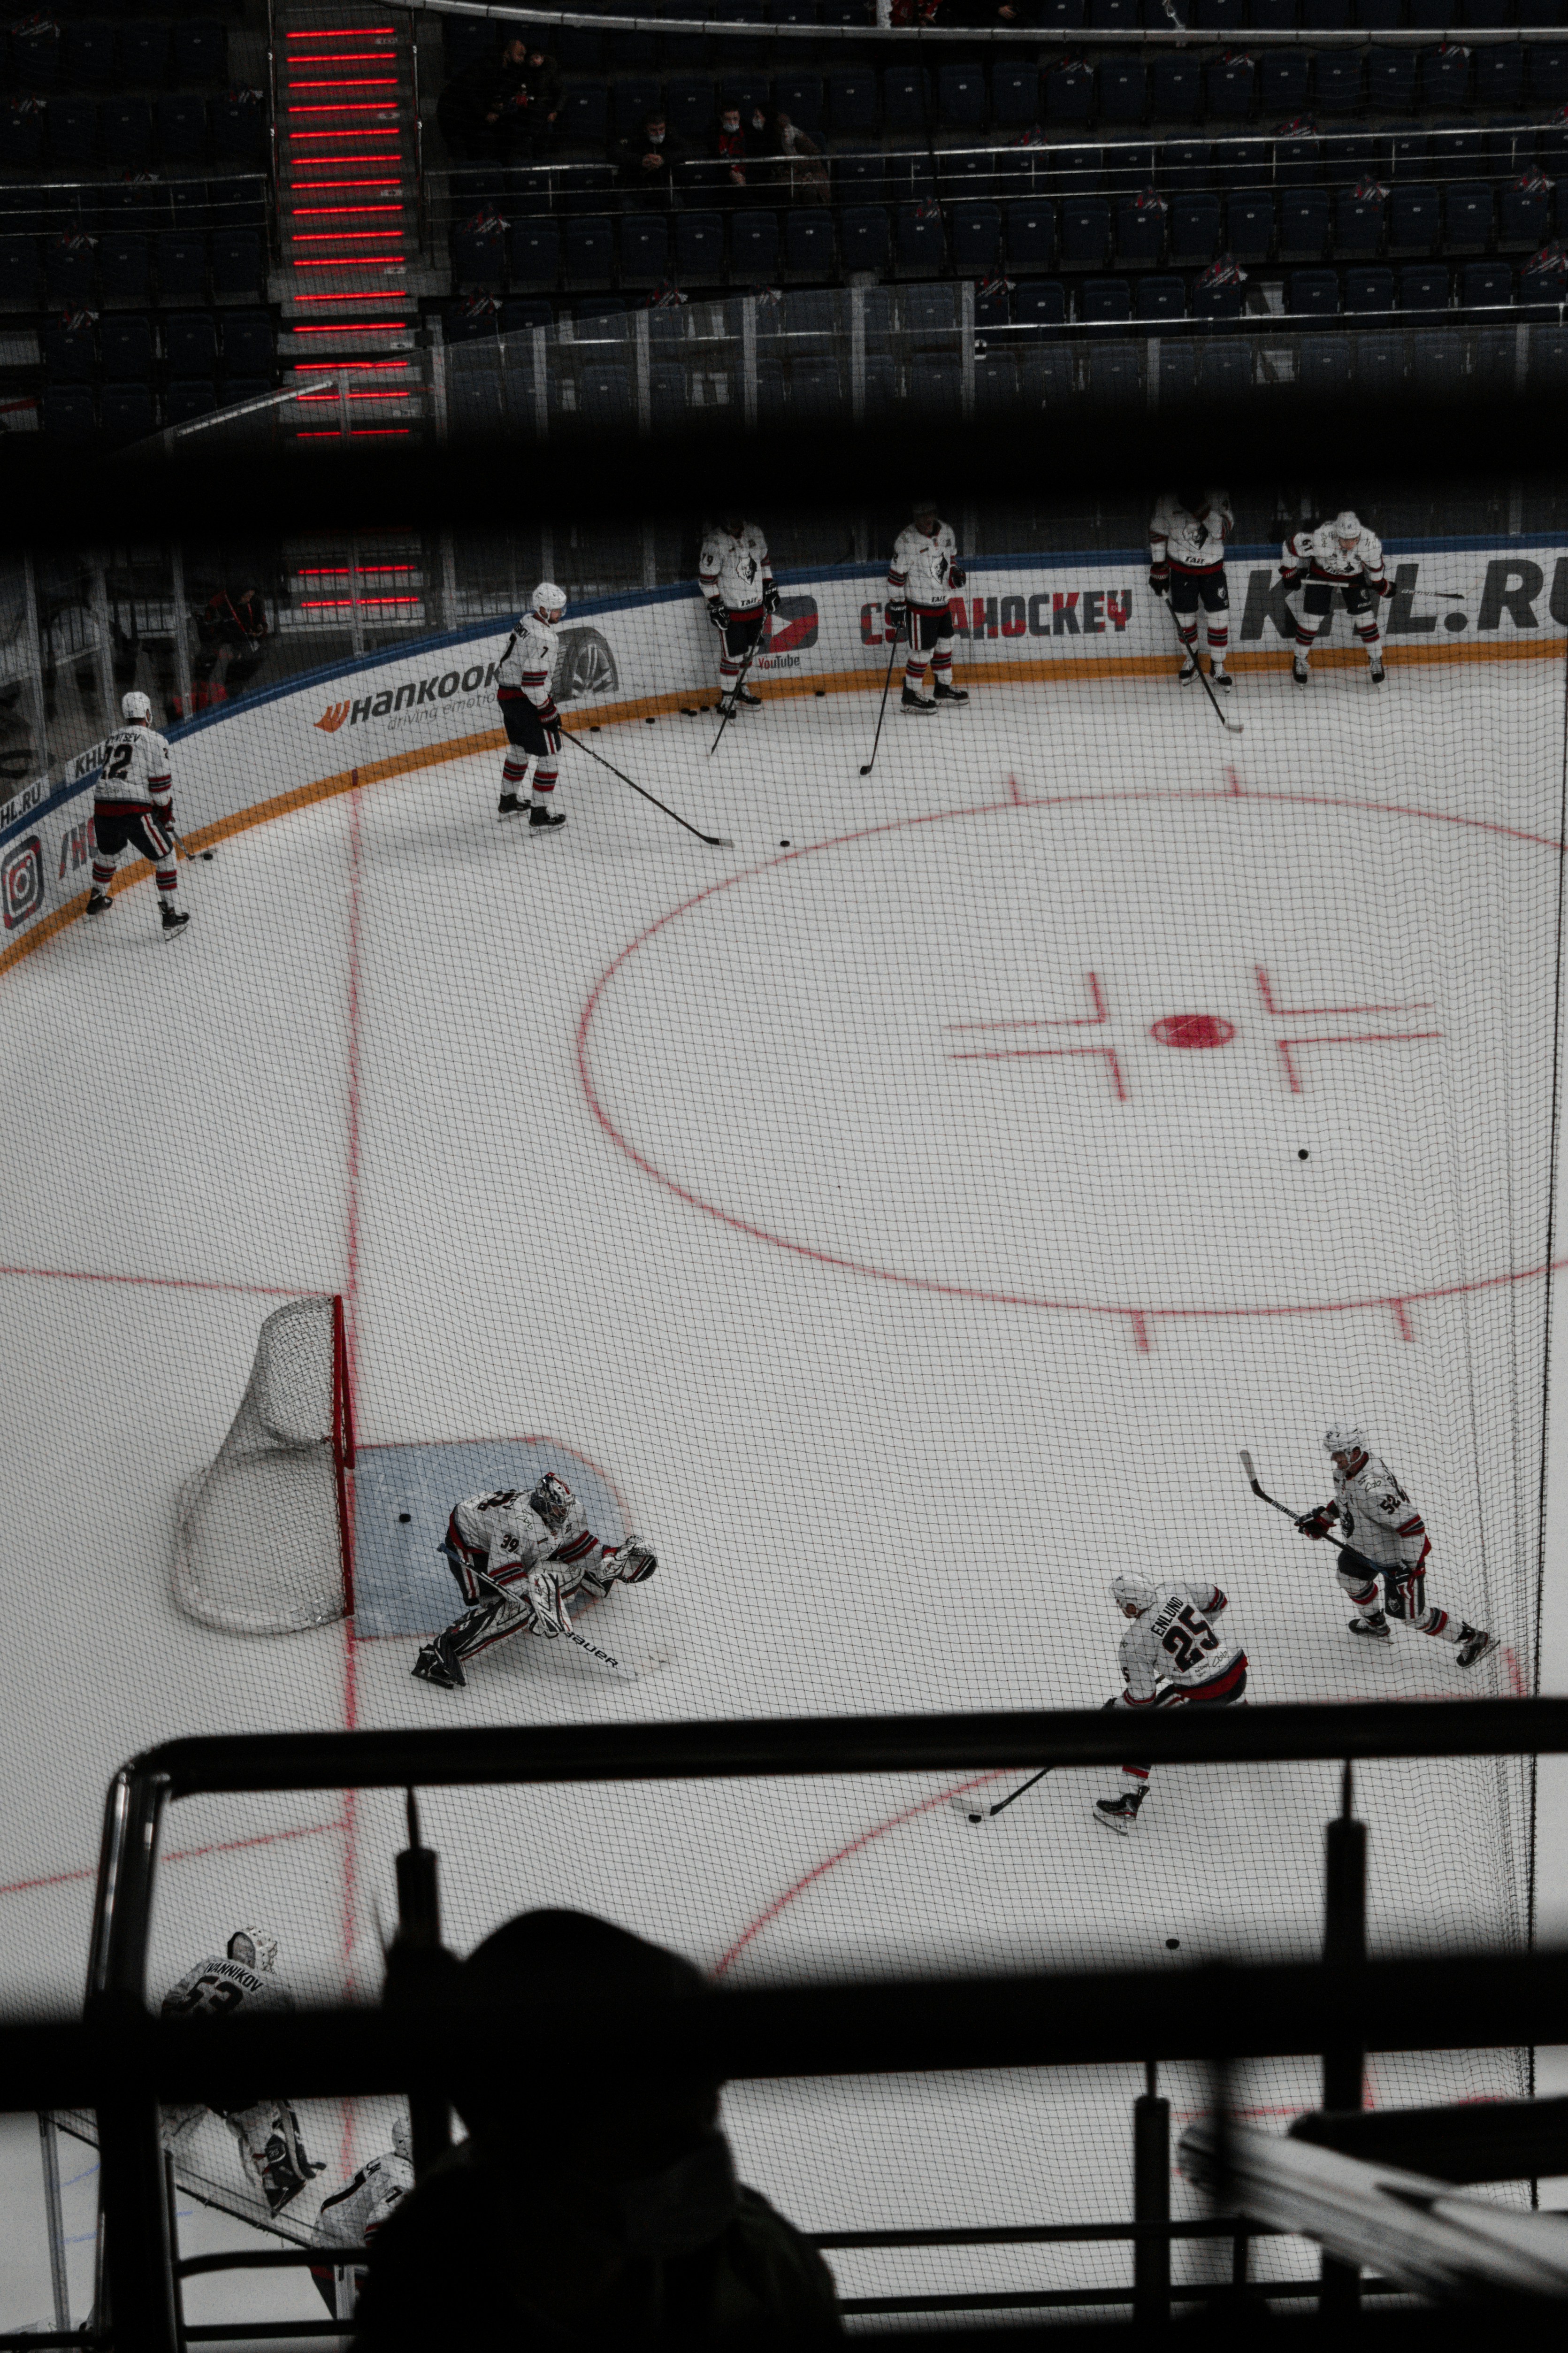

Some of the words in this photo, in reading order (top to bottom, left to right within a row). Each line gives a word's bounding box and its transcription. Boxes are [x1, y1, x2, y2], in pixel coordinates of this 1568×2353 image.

[1240, 557, 1568, 640] KL.R
[861, 589, 1132, 645] CSAHOCKEY
[758, 654, 800, 670] YouTube
[443, 693, 496, 715] emotio
[0, 782, 41, 829] HL.RU
[1380, 1494, 1401, 1515] 52
[501, 1534, 519, 1553] 39
[1151, 1596, 1184, 1638] ENLUND
[1162, 1604, 1219, 1672] 25
[204, 1962, 263, 1992] IVANNIKOV
